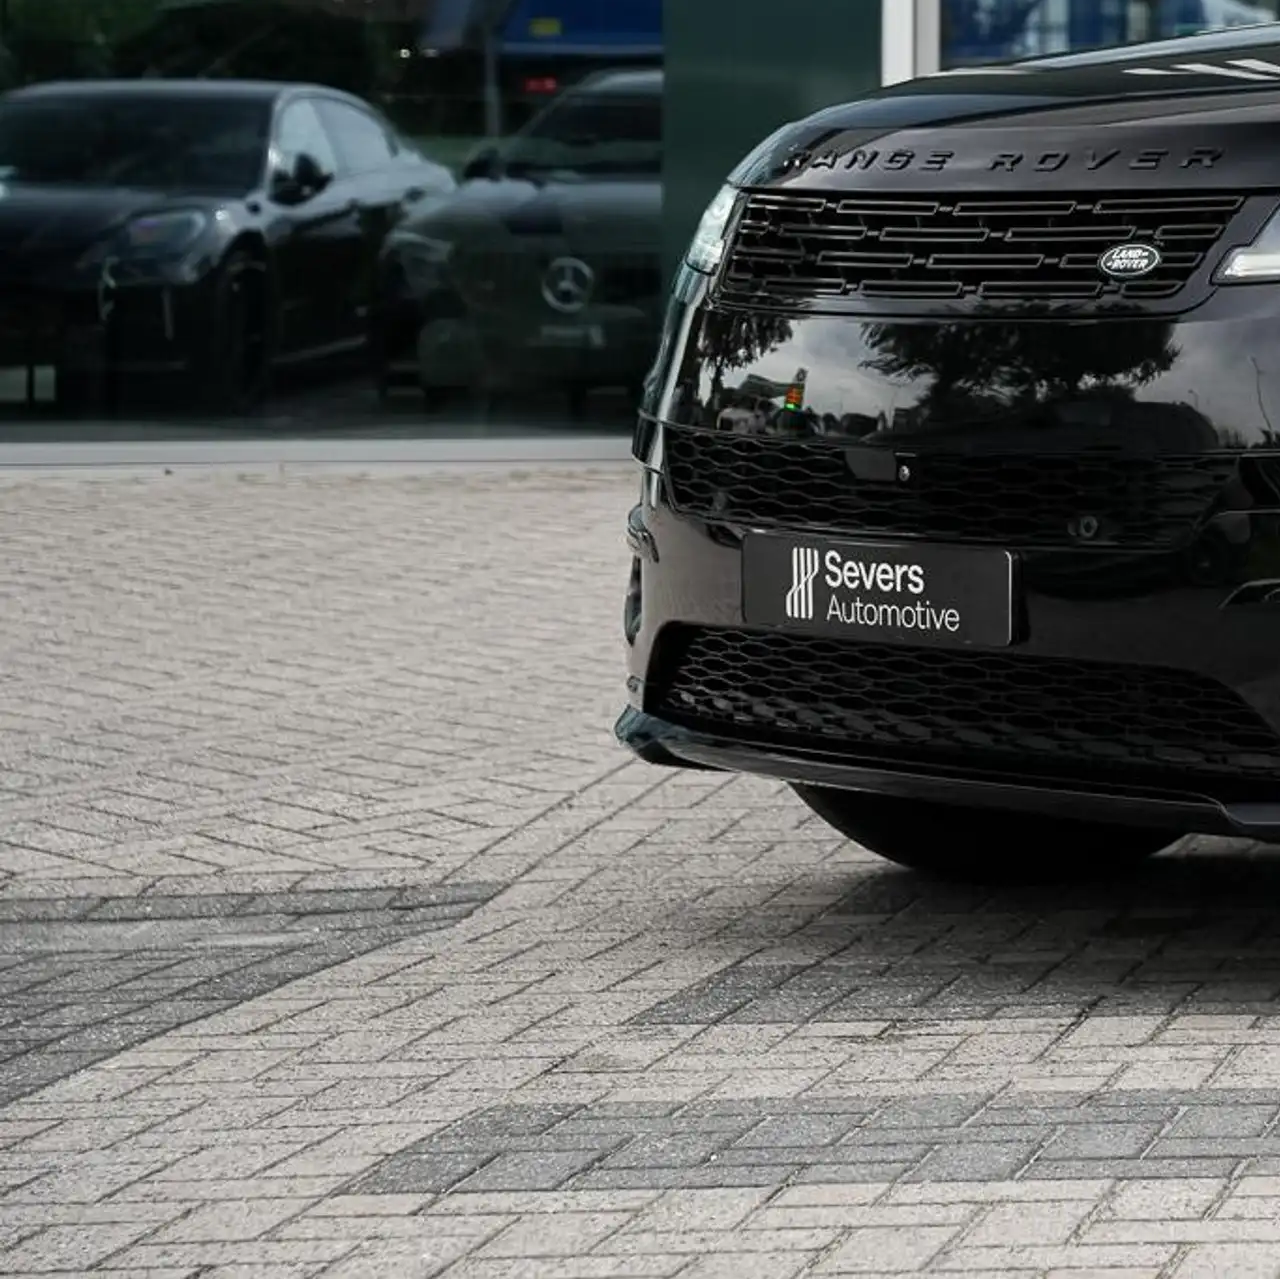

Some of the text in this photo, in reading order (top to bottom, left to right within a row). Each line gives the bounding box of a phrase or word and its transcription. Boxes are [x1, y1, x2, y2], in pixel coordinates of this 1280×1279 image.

[783, 146, 1225, 173] RANGE ROVER
[824, 549, 924, 594] Severs
[826, 593, 960, 632] Automotive
